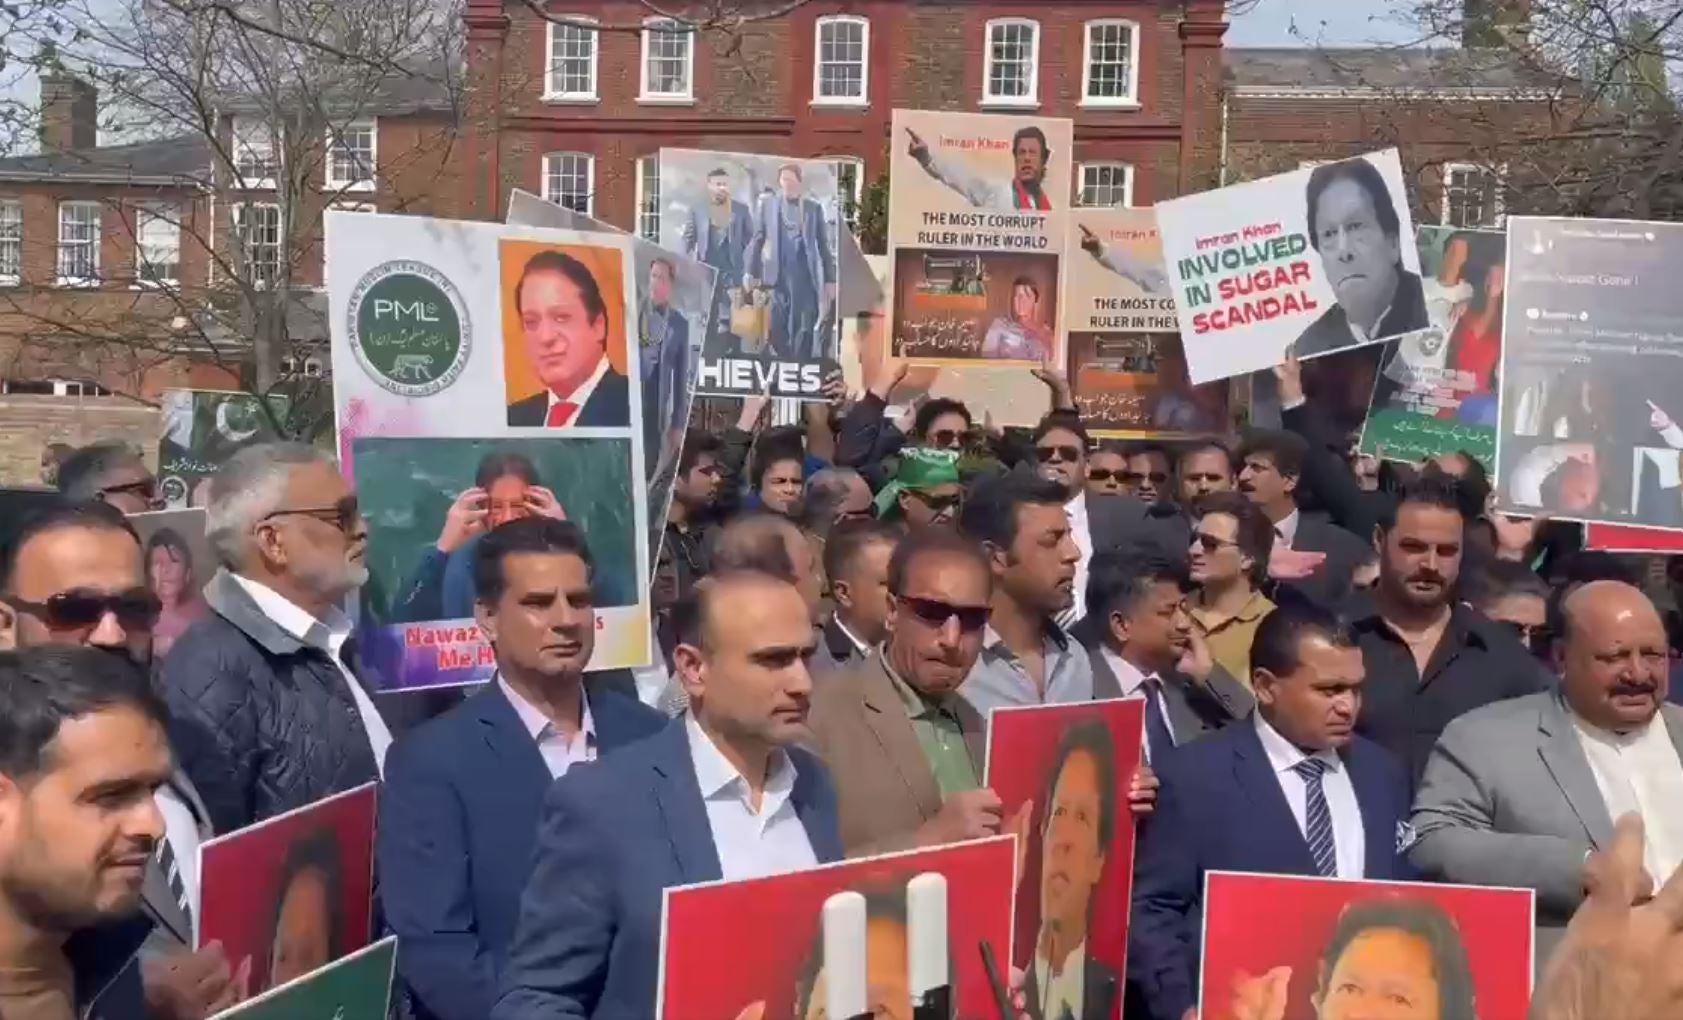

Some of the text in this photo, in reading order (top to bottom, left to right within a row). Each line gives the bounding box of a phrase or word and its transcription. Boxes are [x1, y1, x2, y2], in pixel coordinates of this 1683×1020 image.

[939, 136, 1010, 150] Imran Khan
[922, 212, 1046, 230] THE MOST CORRUPT
[918, 232, 1048, 249] RULER IN THE WORLD
[1195, 222, 1282, 250] Imran Khan
[1178, 233, 1307, 280] INVOLVED
[1185, 283, 1212, 308] IN
[1218, 262, 1312, 300] SUGAR
[1094, 298, 1118, 310] THE
[1120, 298, 1155, 310] MOST
[1193, 290, 1317, 334] SCANDAL
[1090, 316, 1130, 328] RULER
[1132, 317, 1146, 328] IN
[1148, 317, 1173, 328] THE
[698, 357, 821, 392] HIEVES
[405, 626, 479, 645] Nawaz
[438, 649, 472, 671] Me
